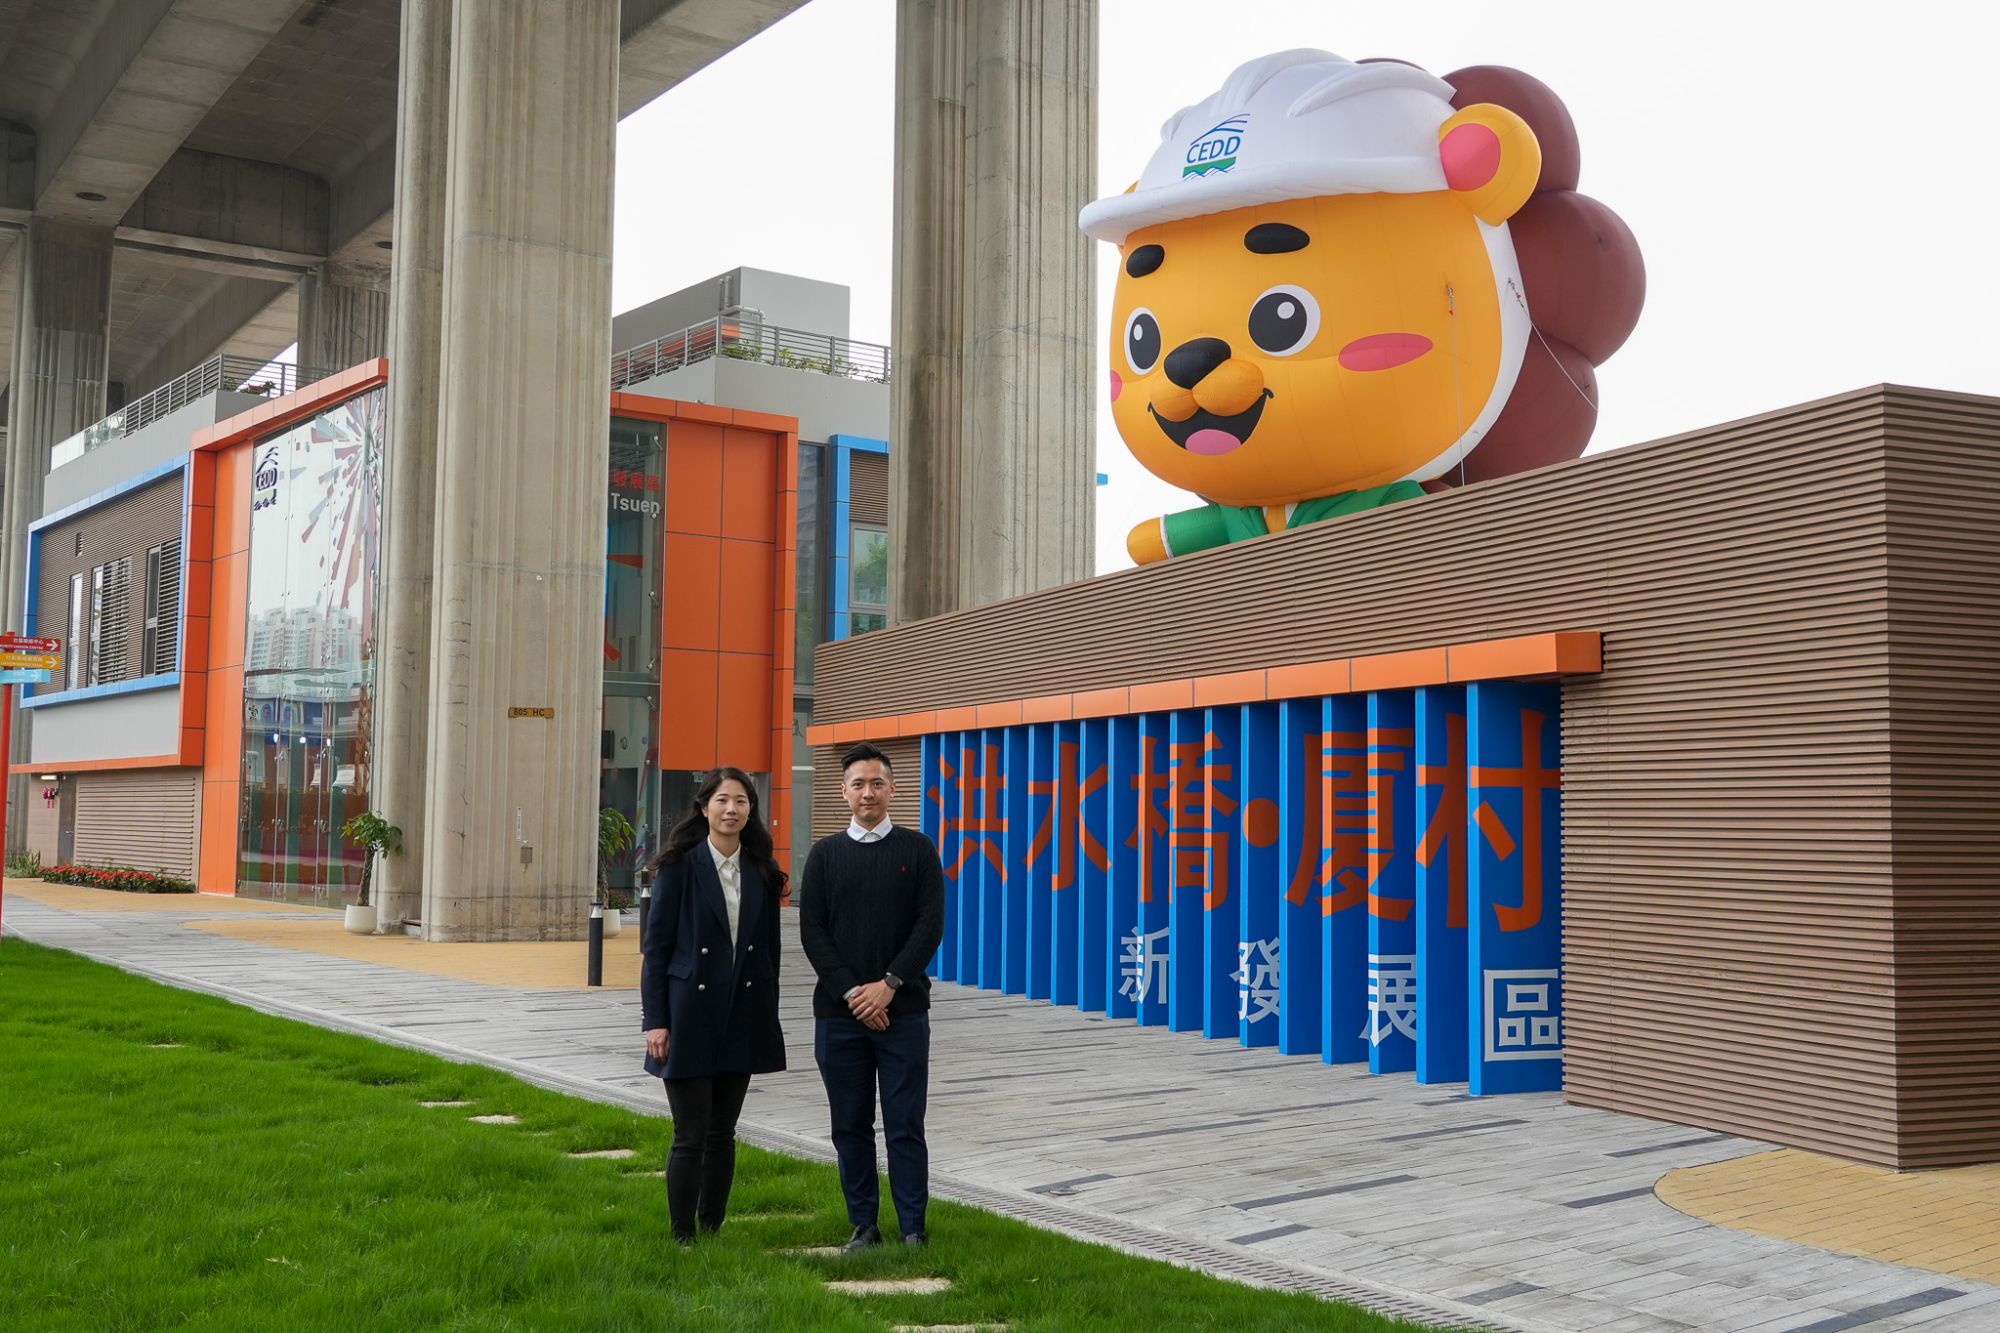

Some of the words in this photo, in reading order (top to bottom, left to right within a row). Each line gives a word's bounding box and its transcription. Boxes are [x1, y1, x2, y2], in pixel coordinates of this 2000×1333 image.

[1186, 136, 1241, 164] CEDD
[256, 467, 278, 491] CEDD
[610, 492, 660, 514] Tsuen
[532, 708, 545, 717] HC
[1118, 926, 1562, 1063] 新發展區
